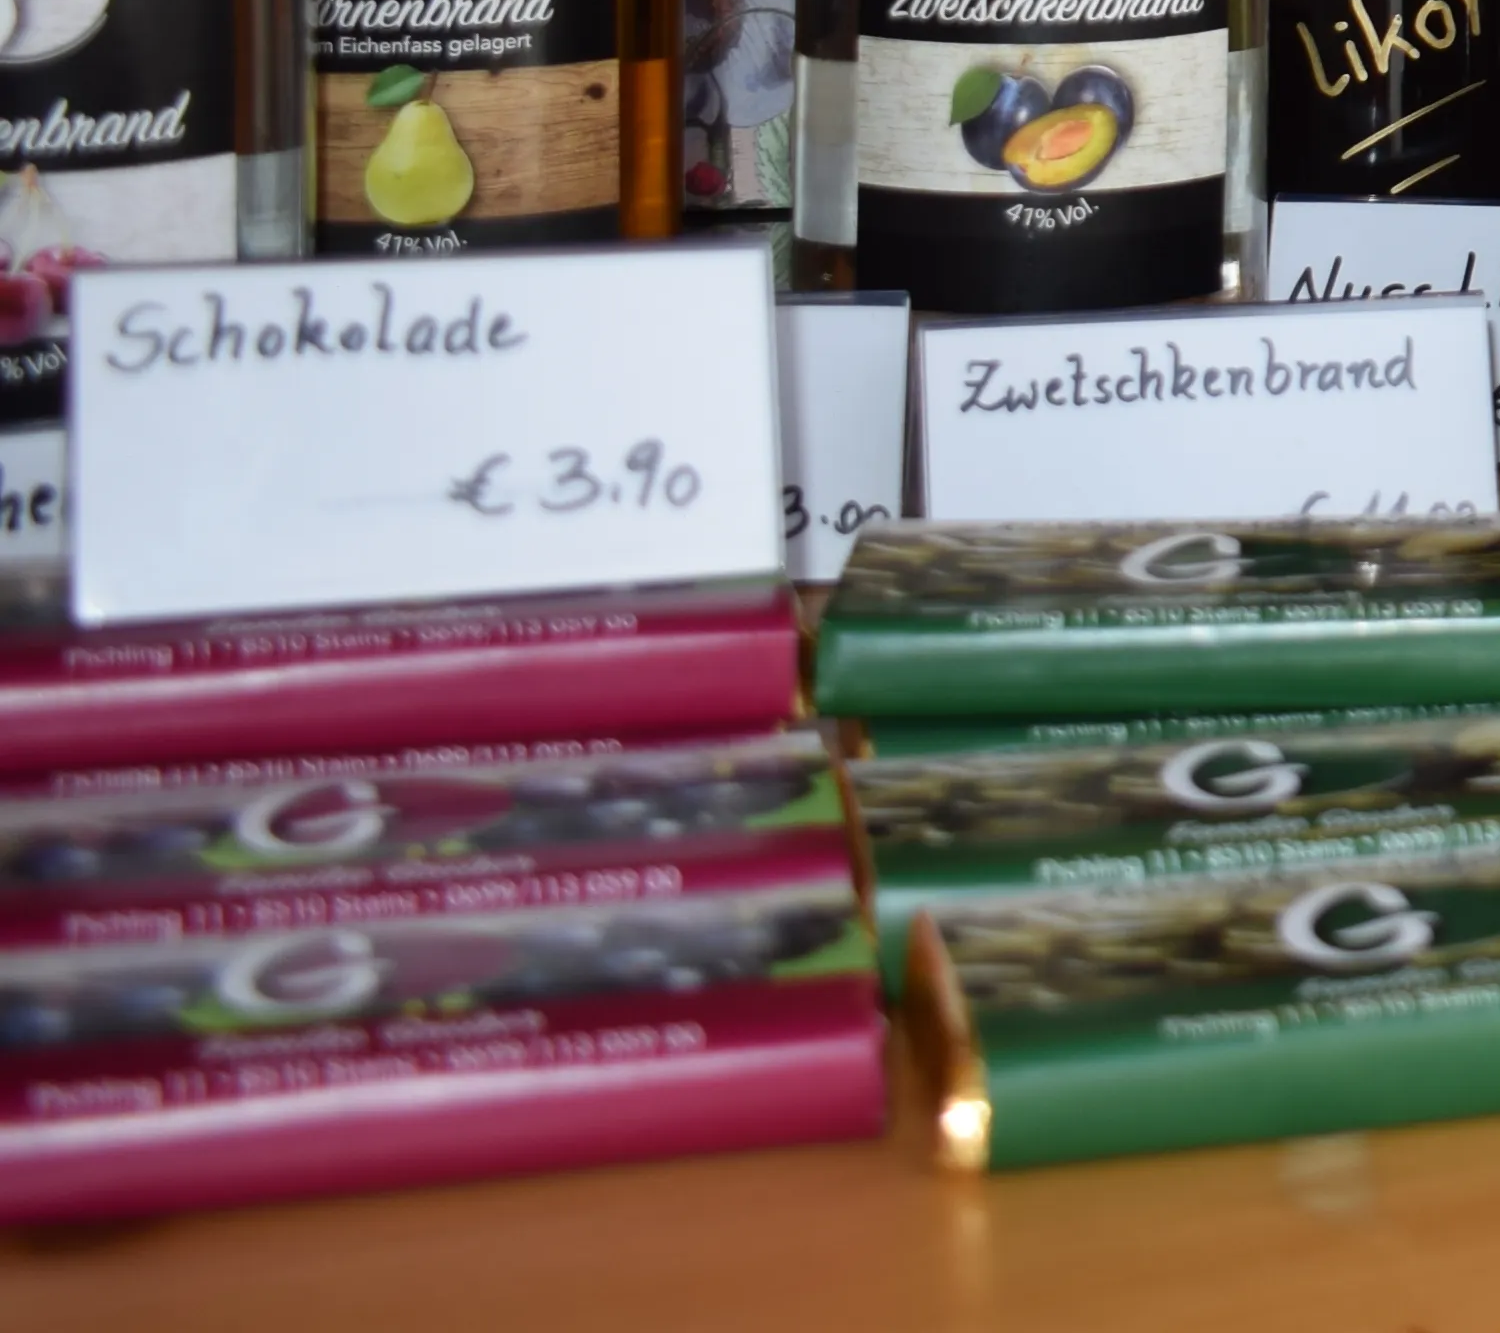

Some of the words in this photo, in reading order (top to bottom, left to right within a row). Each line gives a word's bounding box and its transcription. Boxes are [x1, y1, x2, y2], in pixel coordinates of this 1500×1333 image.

[340, 35, 443, 54] Eichenfass
[448, 31, 533, 57] gelagert
[1004, 201, 1055, 231] 47%
[1055, 196, 1101, 227] Vol.
[104, 281, 530, 375] Schokolade
[958, 336, 1417, 415] Zwetschkenbrand
[447, 453, 515, 517] €
[538, 437, 704, 516] 3.90
[1161, 740, 1310, 815] G
[231, 779, 394, 858] G
[1277, 881, 1442, 971] G
[217, 932, 390, 1013] G
